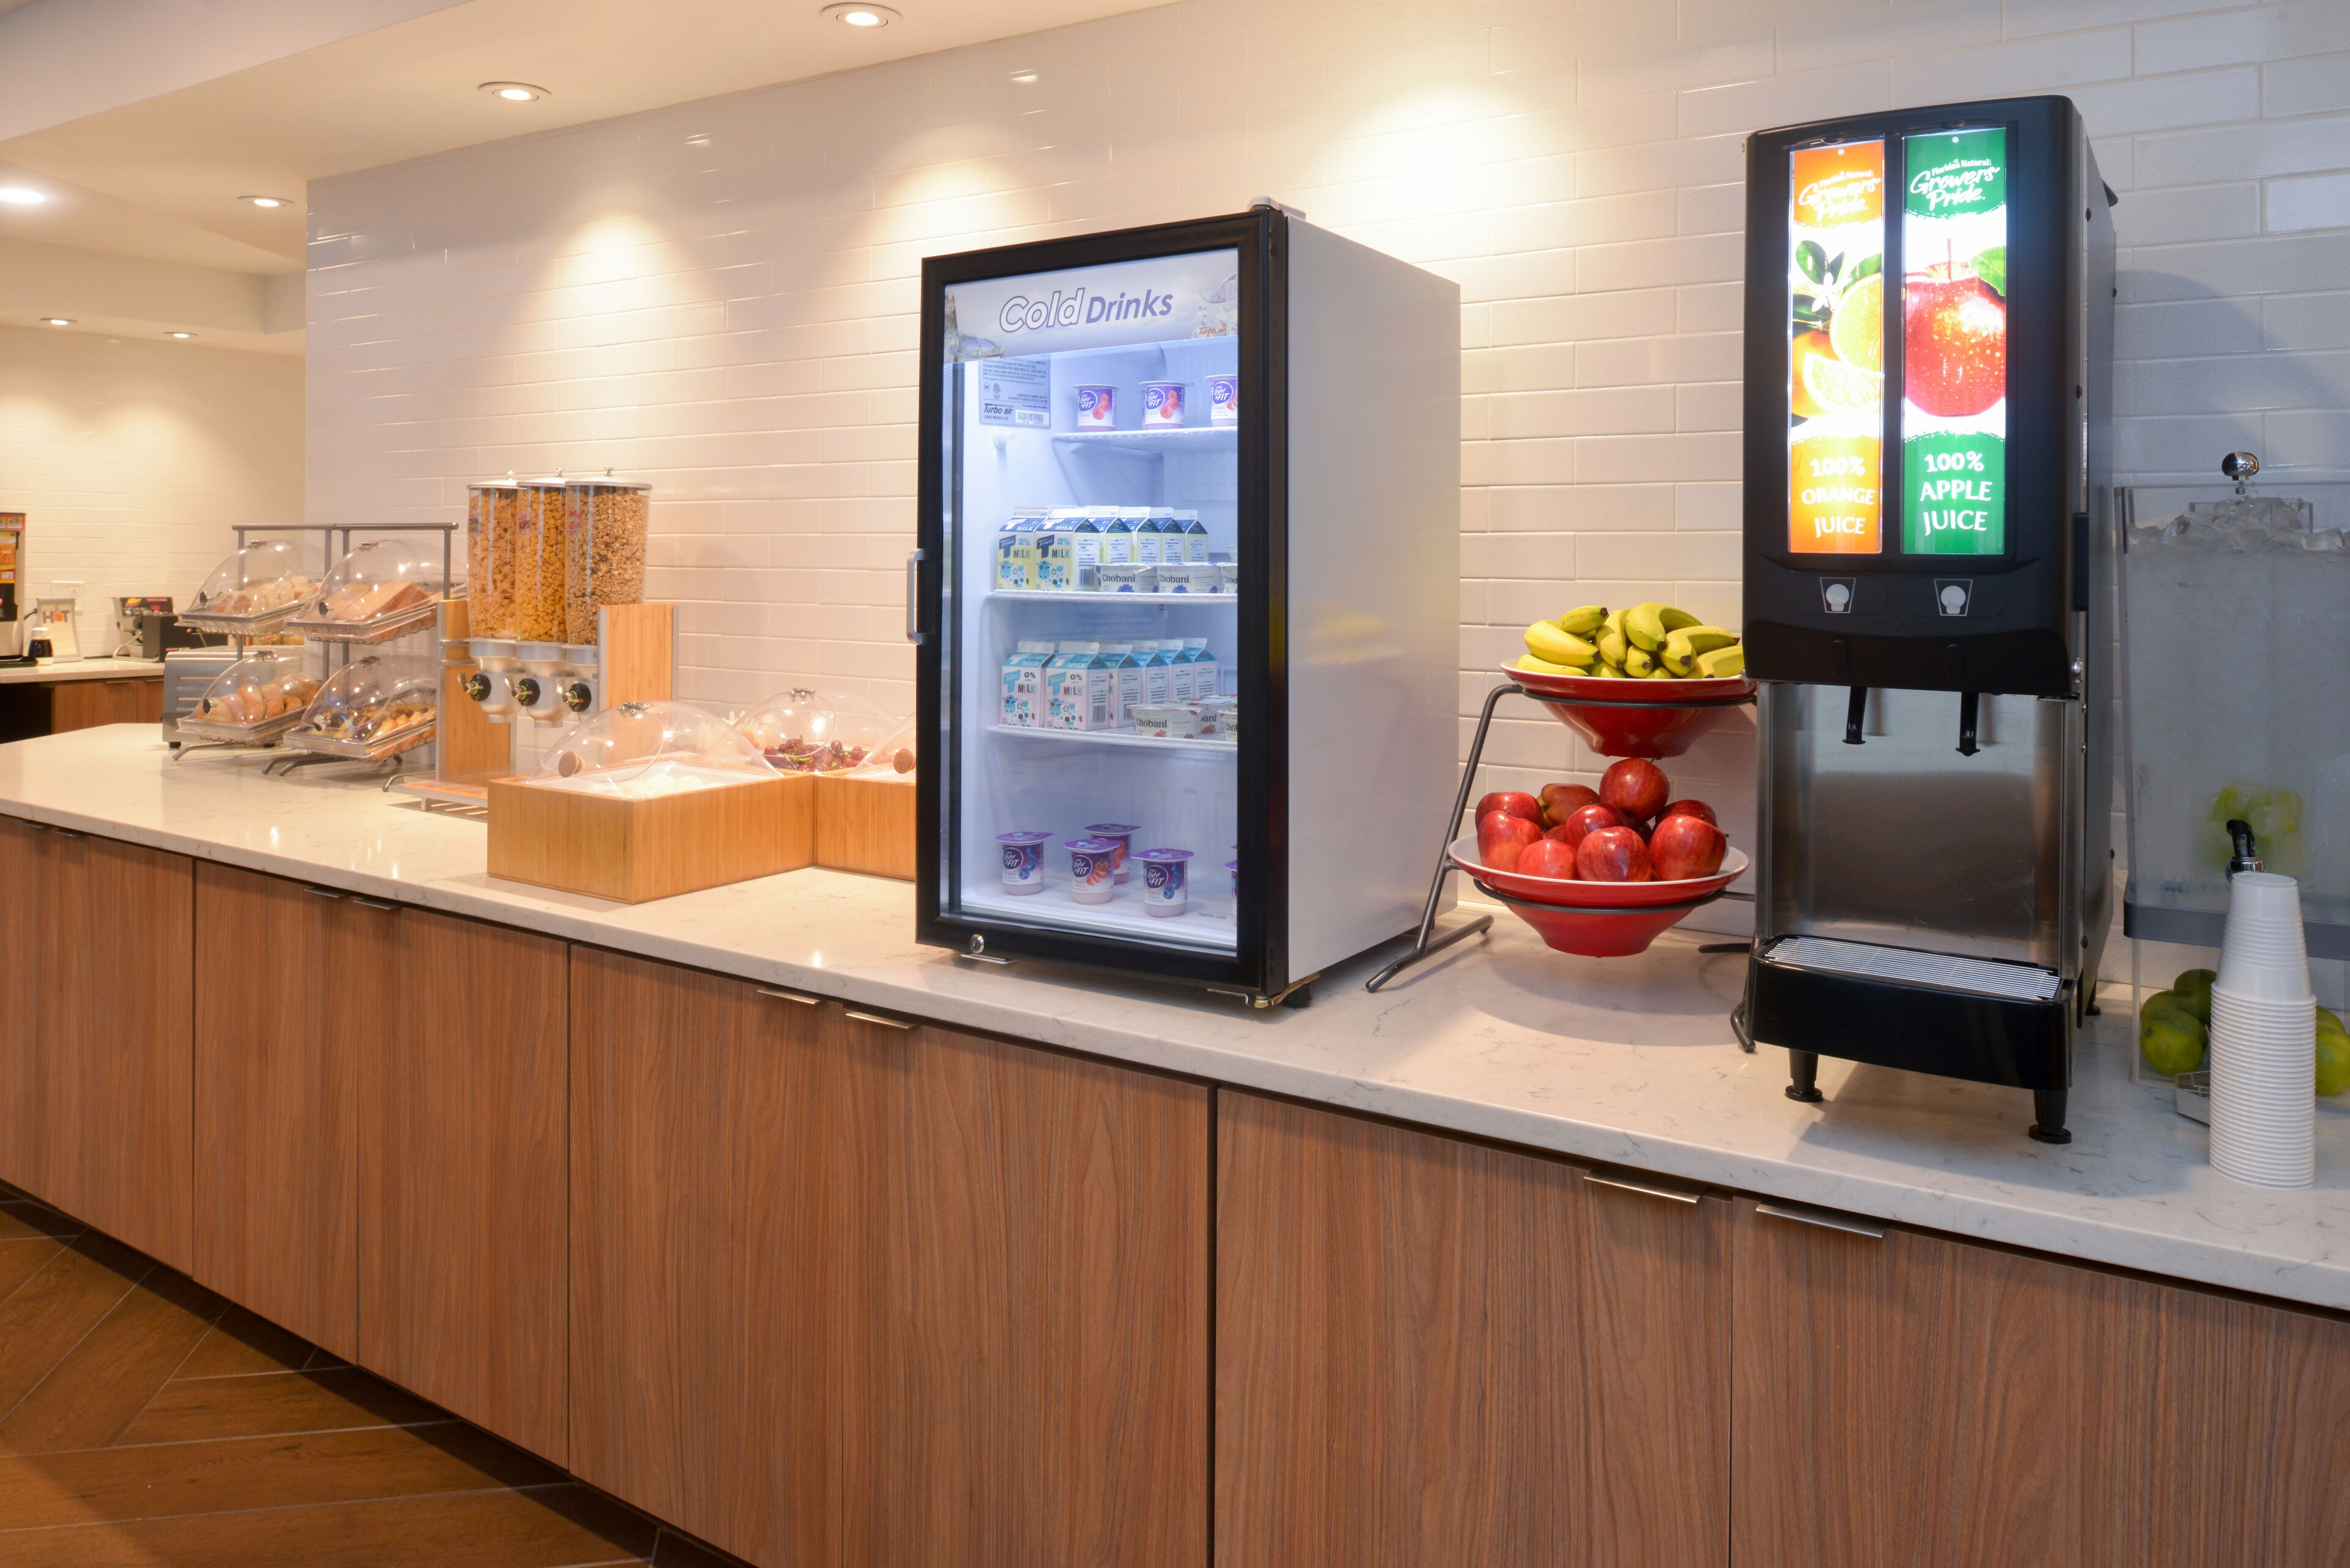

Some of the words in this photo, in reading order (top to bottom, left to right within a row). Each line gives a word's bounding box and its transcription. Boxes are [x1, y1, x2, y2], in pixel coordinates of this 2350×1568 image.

[1961, 159, 1989, 168] Natural
[999, 287, 1085, 333] Cold
[1086, 289, 1174, 324] Drinks
[984, 403, 1002, 414] Turbo
[1004, 406, 1013, 415] air
[1810, 455, 1865, 477] 100%
[1924, 451, 1984, 472] 100%
[1801, 486, 1876, 505] ORANGE
[1920, 480, 1993, 501] APPLE
[1814, 516, 1866, 538] JUICE
[1923, 510, 1988, 536] JUICE
[1013, 549, 1031, 558] MILK
[1052, 549, 1070, 558] MILK
[1102, 573, 1135, 583] Chobani
[1159, 574, 1189, 583] Chobani
[1018, 684, 1035, 693] MILK
[1064, 687, 1083, 696] MILK
[1136, 718, 1167, 728] Chobani
